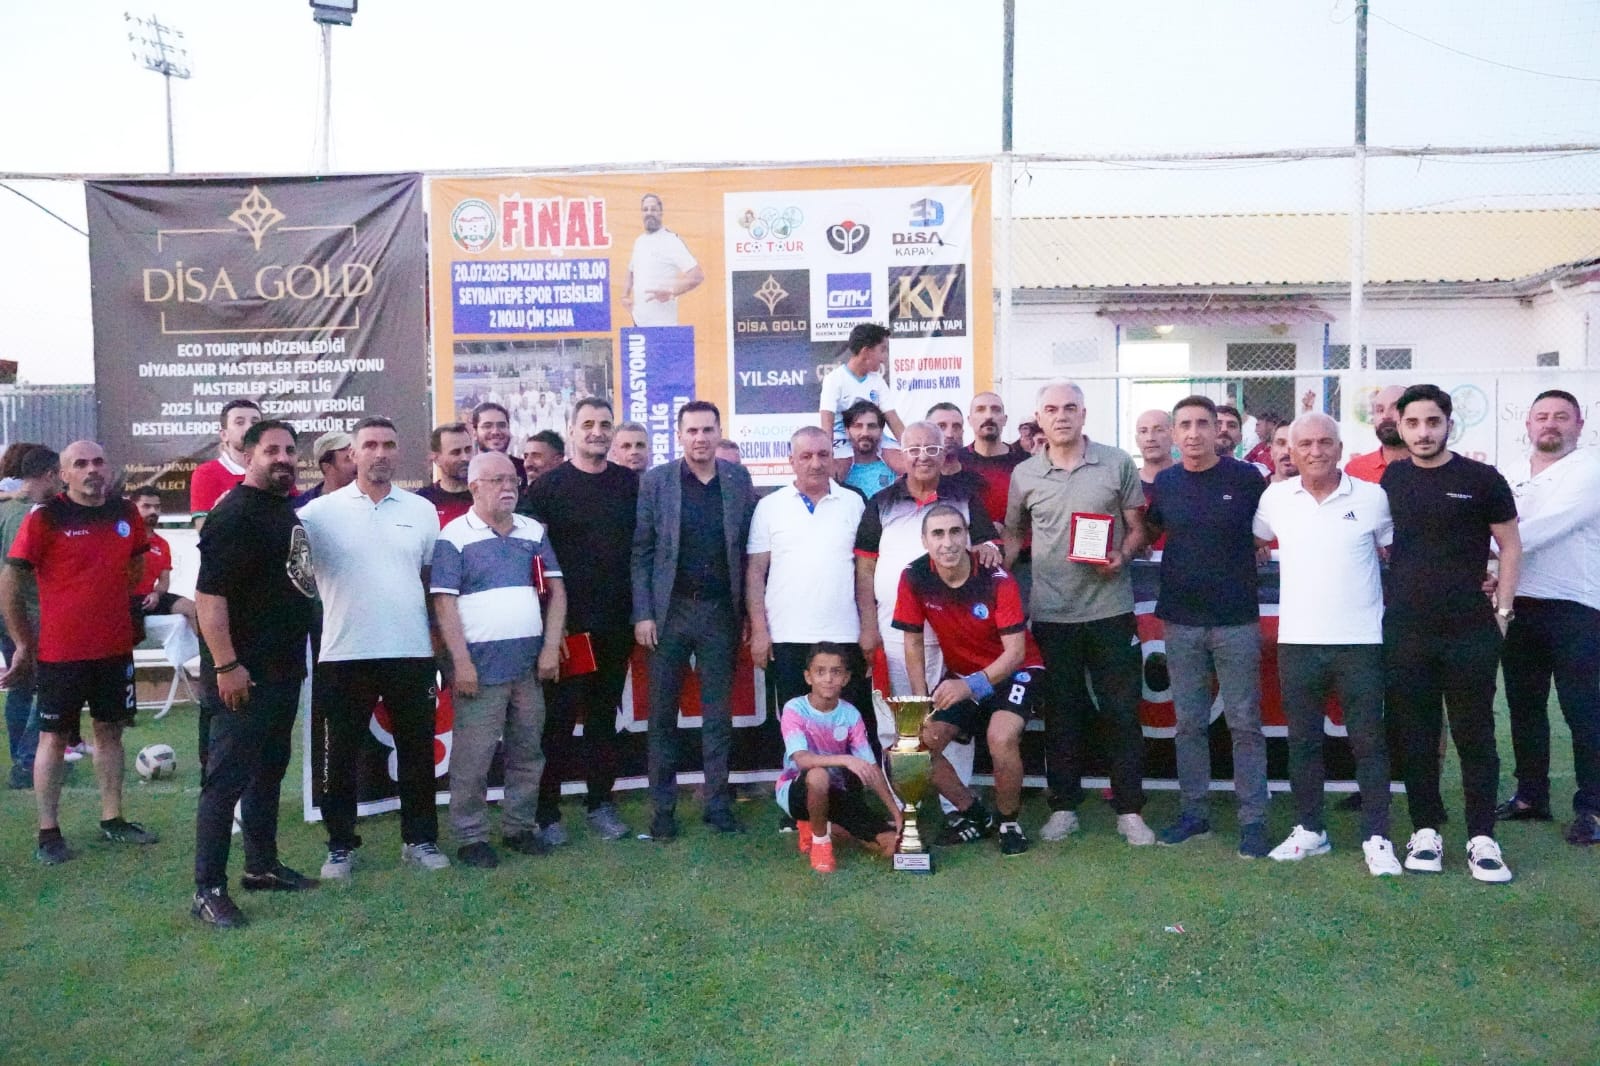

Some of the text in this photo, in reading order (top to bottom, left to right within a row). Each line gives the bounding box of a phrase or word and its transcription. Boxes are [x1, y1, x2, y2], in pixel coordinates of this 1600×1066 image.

[895, 247, 935, 257] KAPAK
[454, 263, 510, 282] 20.07.2025
[510, 263, 545, 282] PAZAR
[545, 262, 571, 280] SAAT
[578, 261, 607, 280] 18.00
[143, 261, 373, 303] DİSA GOLD
[459, 281, 604, 305] SEYRANTEPE SPOR TESİSLERİ
[828, 289, 871, 307] GMY
[898, 274, 958, 319] KY
[489, 306, 575, 330] 2 NOLU ÇİM SAHA
[737, 319, 807, 333] DİSA GOLD
[920, 320, 942, 332] KAYA
[943, 320, 963, 330] YAPI
[177, 338, 346, 357] ECO TOUR'UN DÜZENLEDİĞİ
[139, 358, 385, 377] DİYARBAKIR MASTERLER FEDERASYONU
[193, 379, 332, 396] MASTERLER SÜPER LİG
[739, 370, 804, 387] YILSAN
[939, 376, 961, 389] KAYA
[161, 402, 193, 416] 2025
[261, 399, 312, 414] SEZONU
[313, 396, 365, 412] VERDİĞİ
[649, 402, 669, 430] LİG
[1007, 683, 1026, 705] 8
